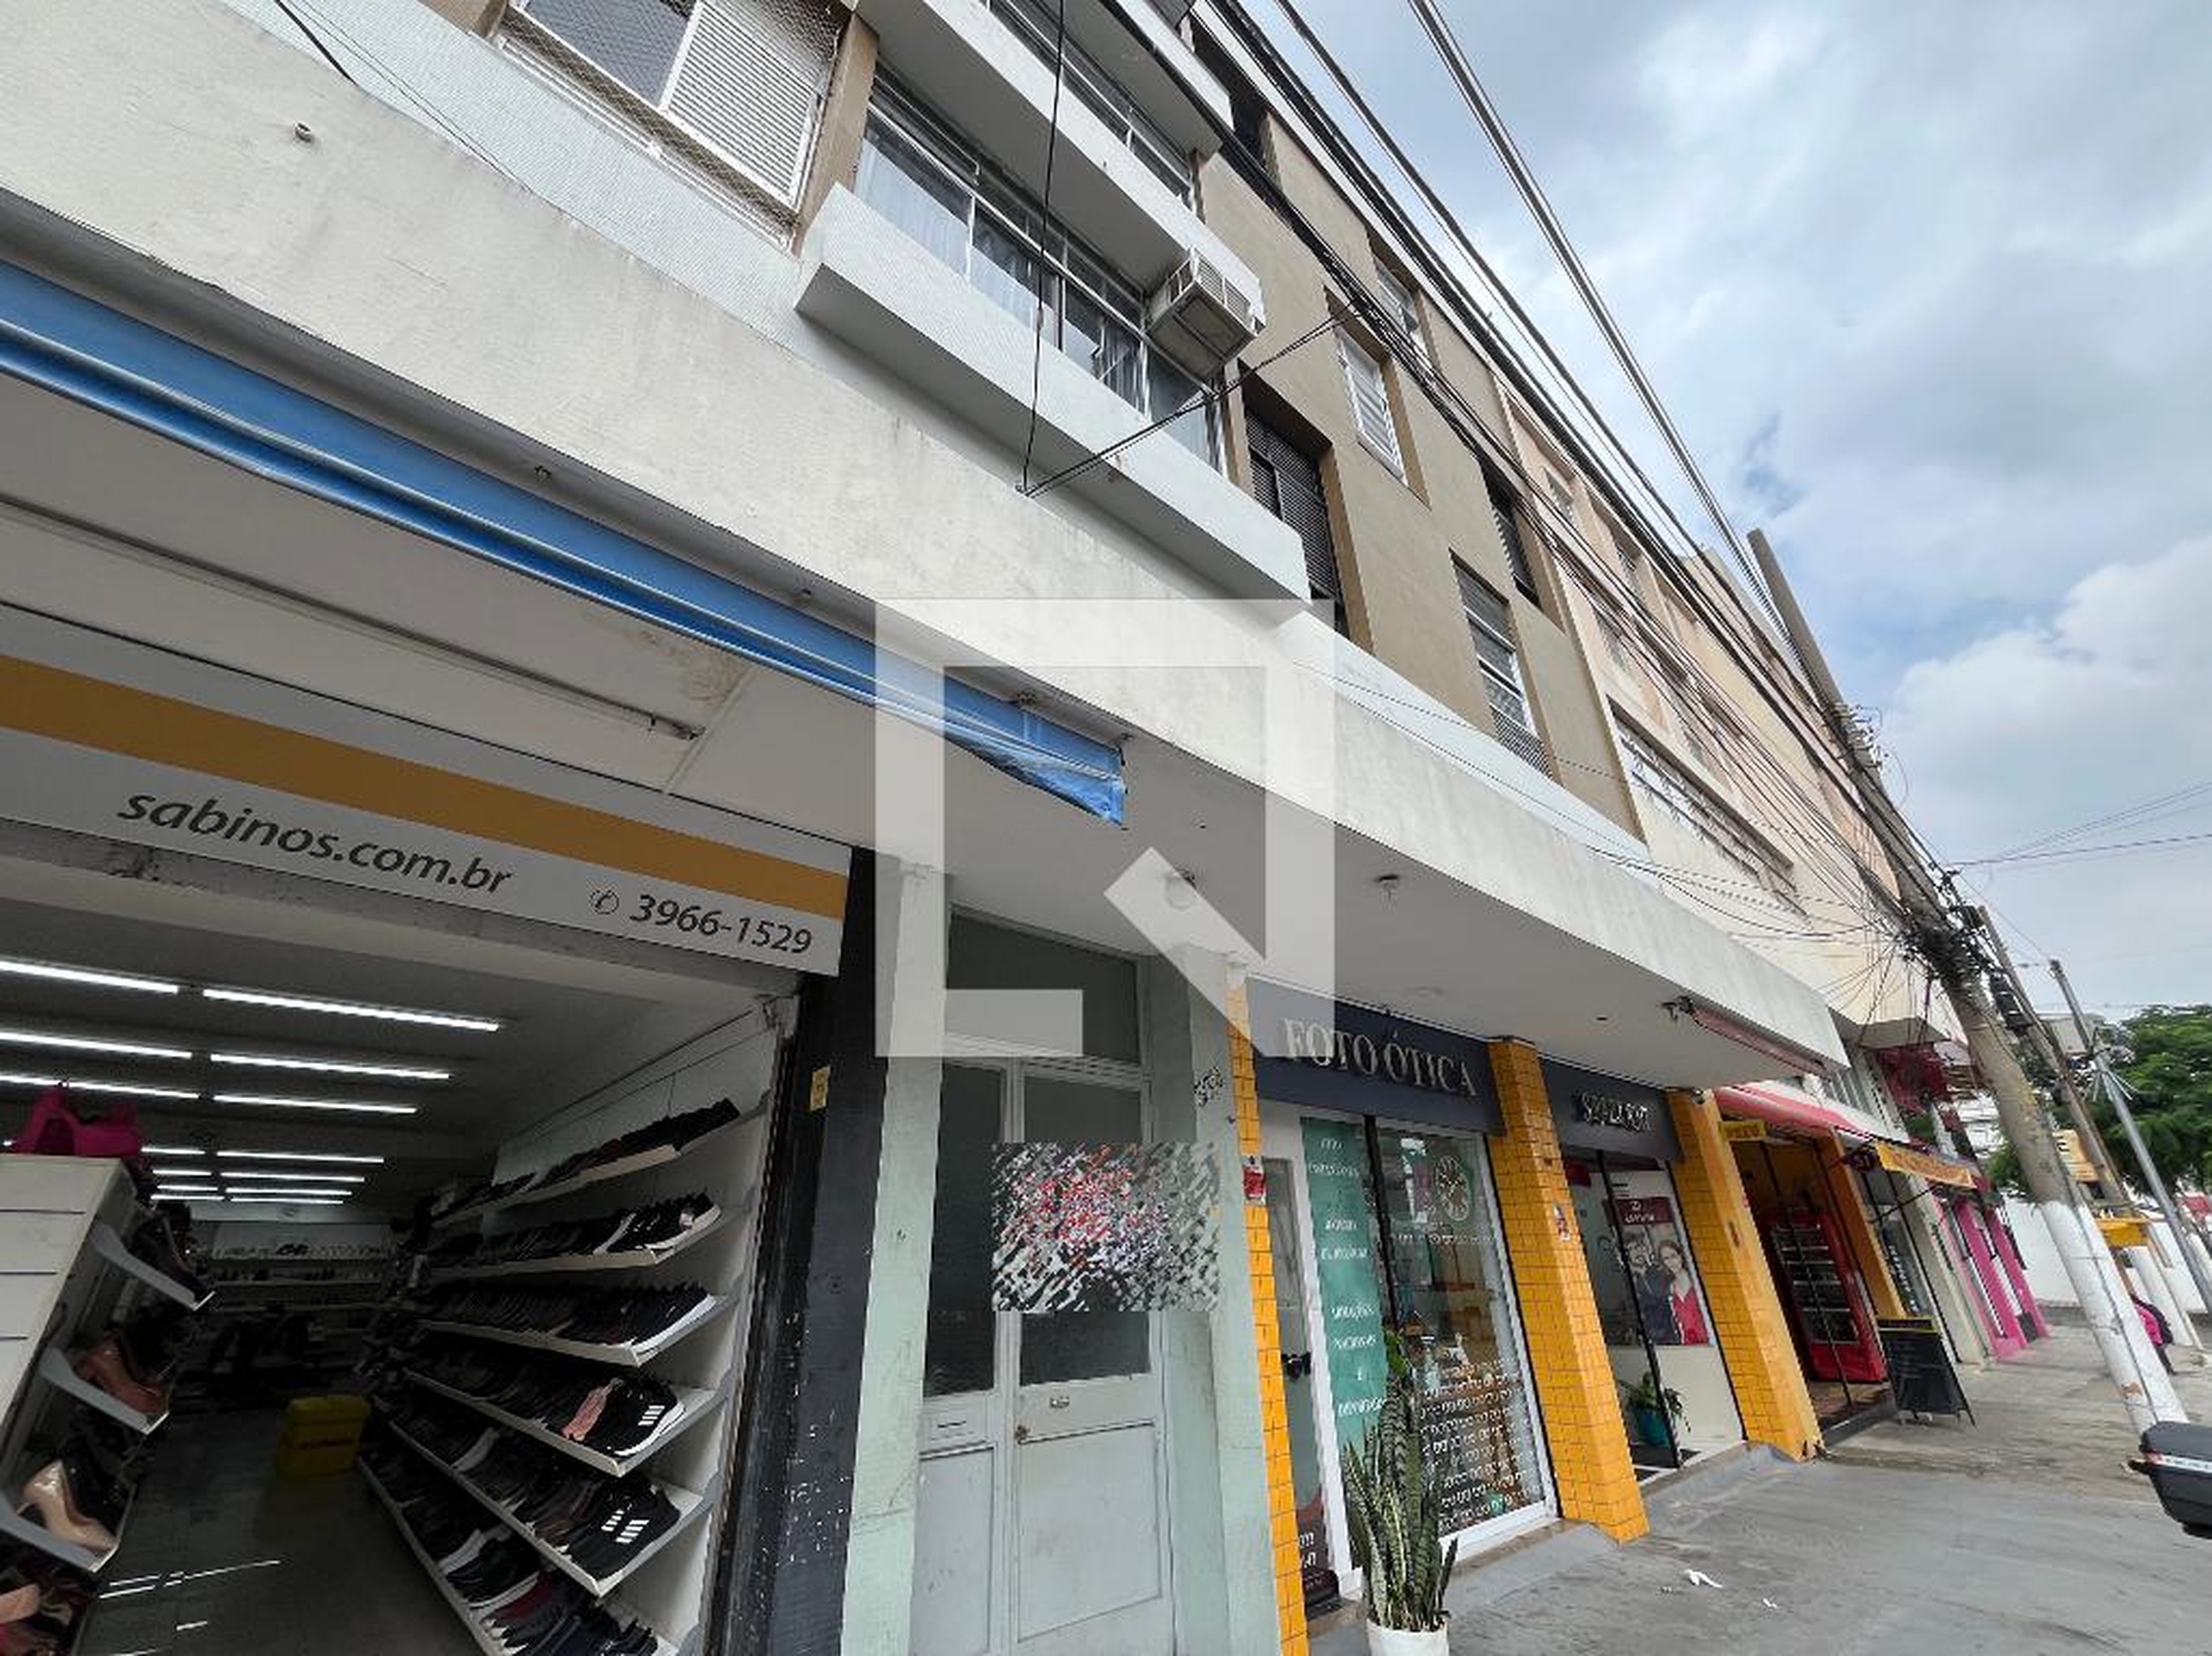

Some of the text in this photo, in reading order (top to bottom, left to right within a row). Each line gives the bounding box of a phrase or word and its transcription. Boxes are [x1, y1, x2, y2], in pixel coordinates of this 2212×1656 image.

[117, 795, 812, 953] sabinos.com.br 3966-1529
[1285, 1018, 1476, 1095] FOTO ÓTICA
